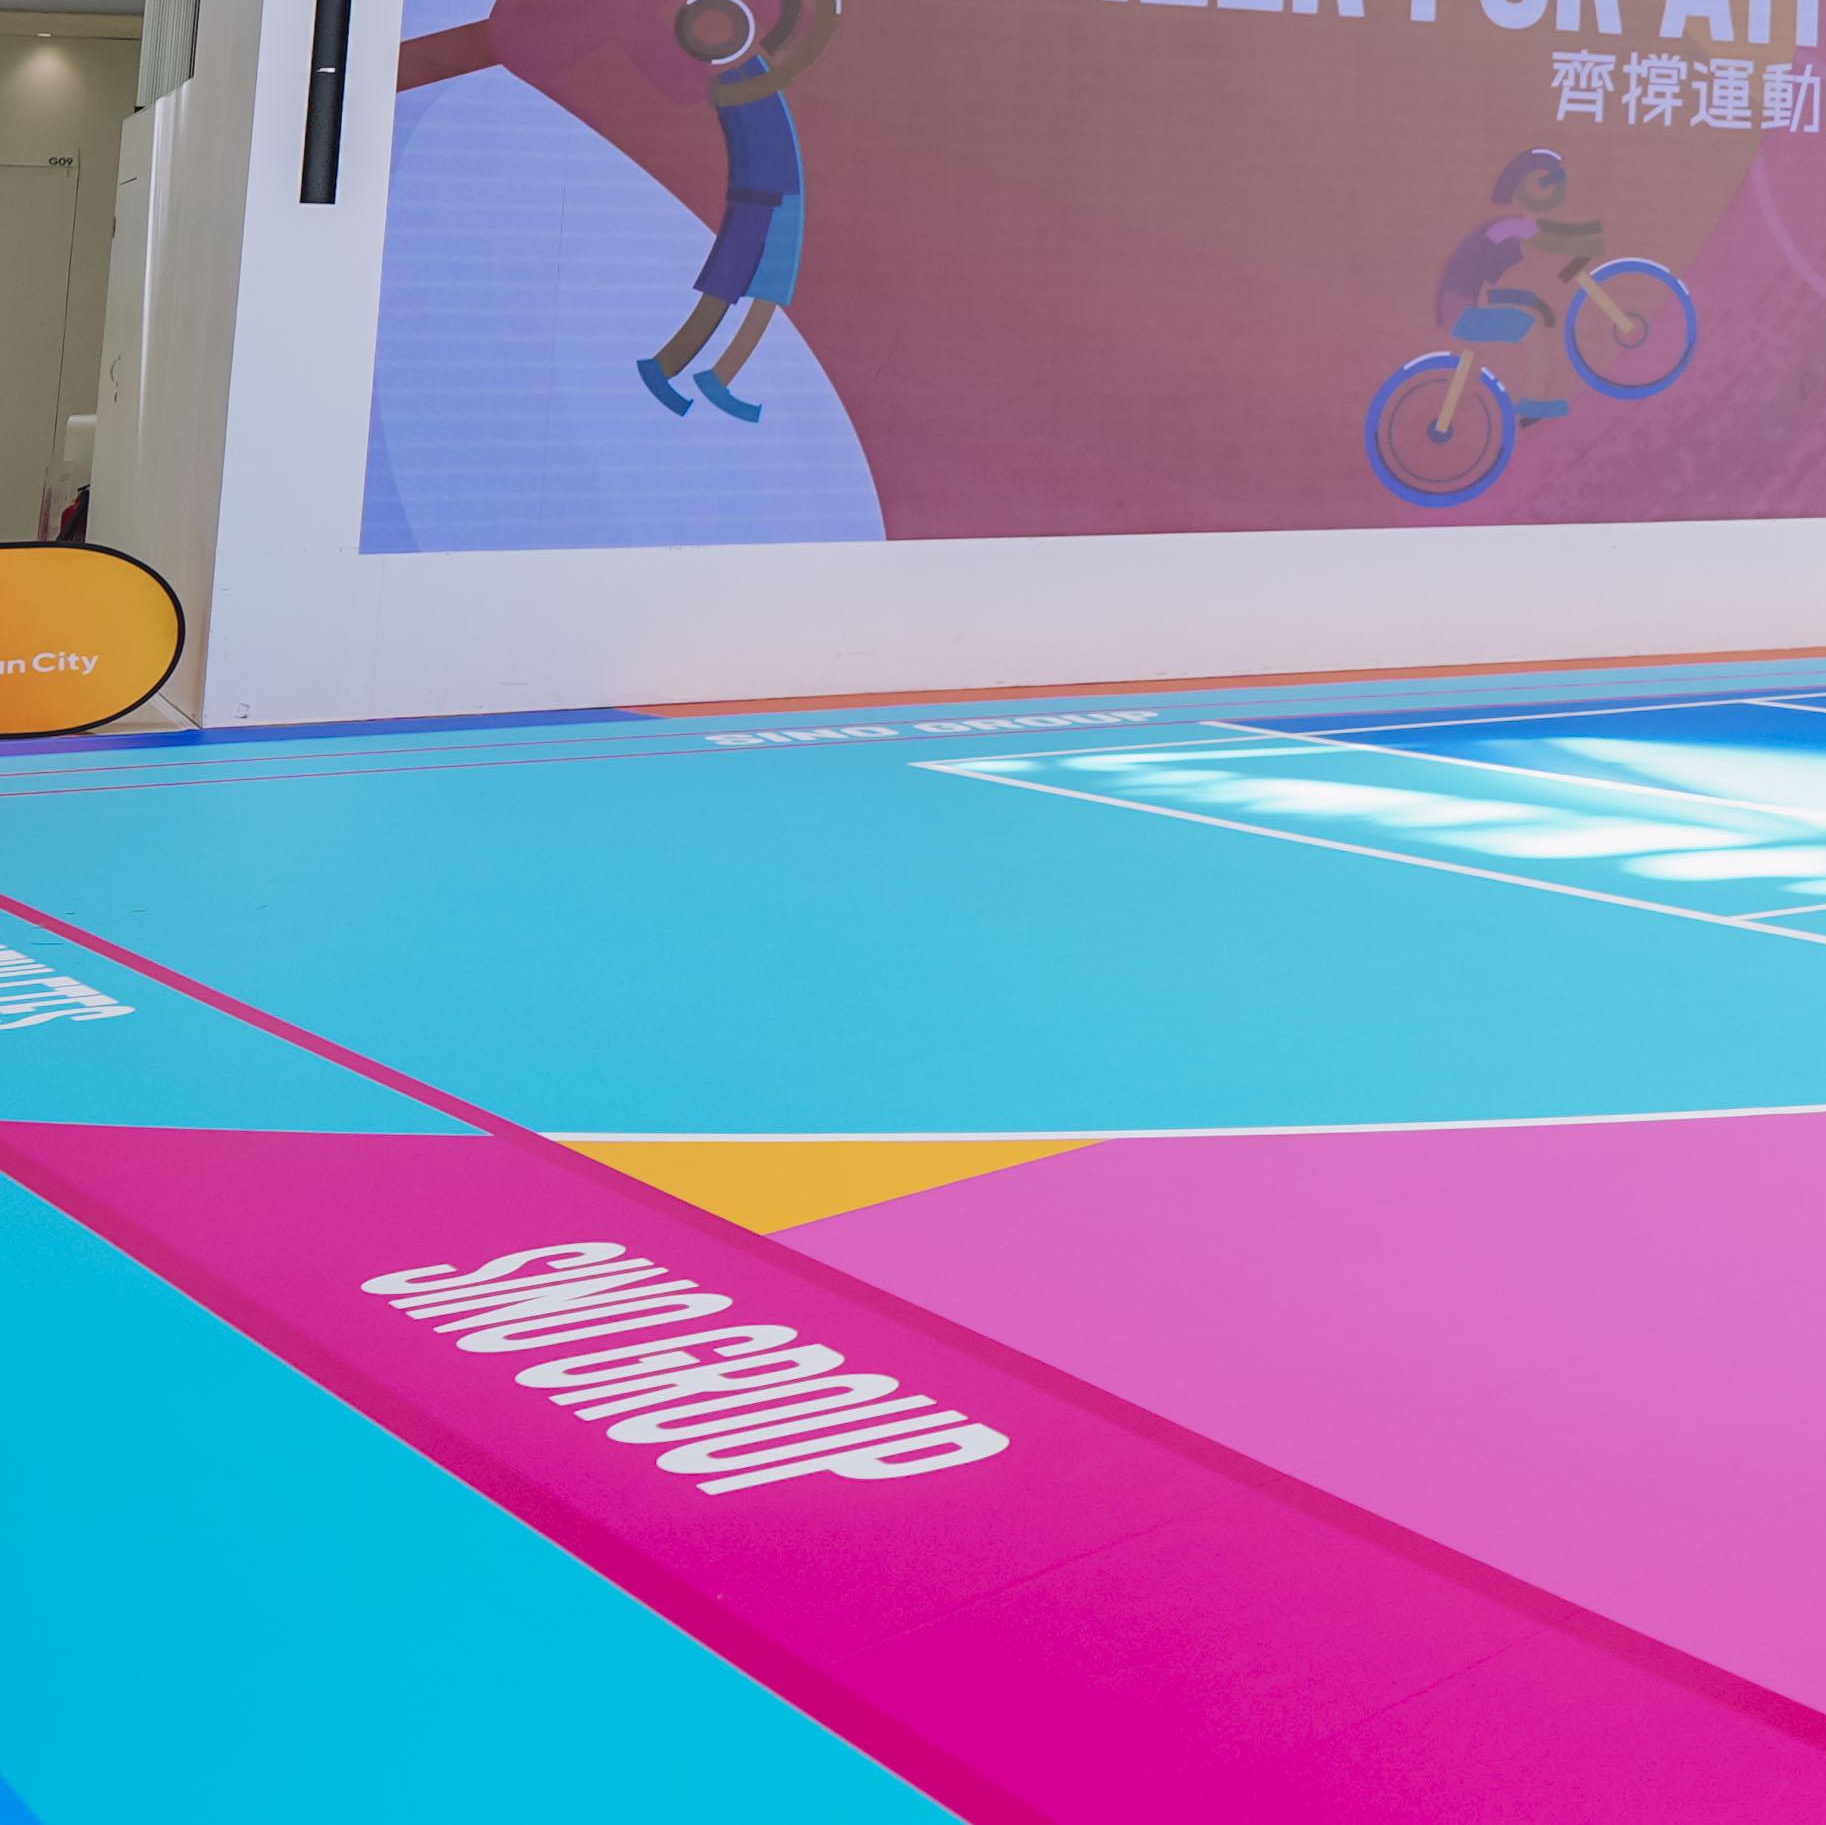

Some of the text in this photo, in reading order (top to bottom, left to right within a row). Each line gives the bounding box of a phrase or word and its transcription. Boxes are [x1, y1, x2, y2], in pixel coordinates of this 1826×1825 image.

[32, 652, 99, 675] City
[704, 710, 1160, 747] SINO GROUP
[360, 1242, 1010, 1496] SINO GROUP
